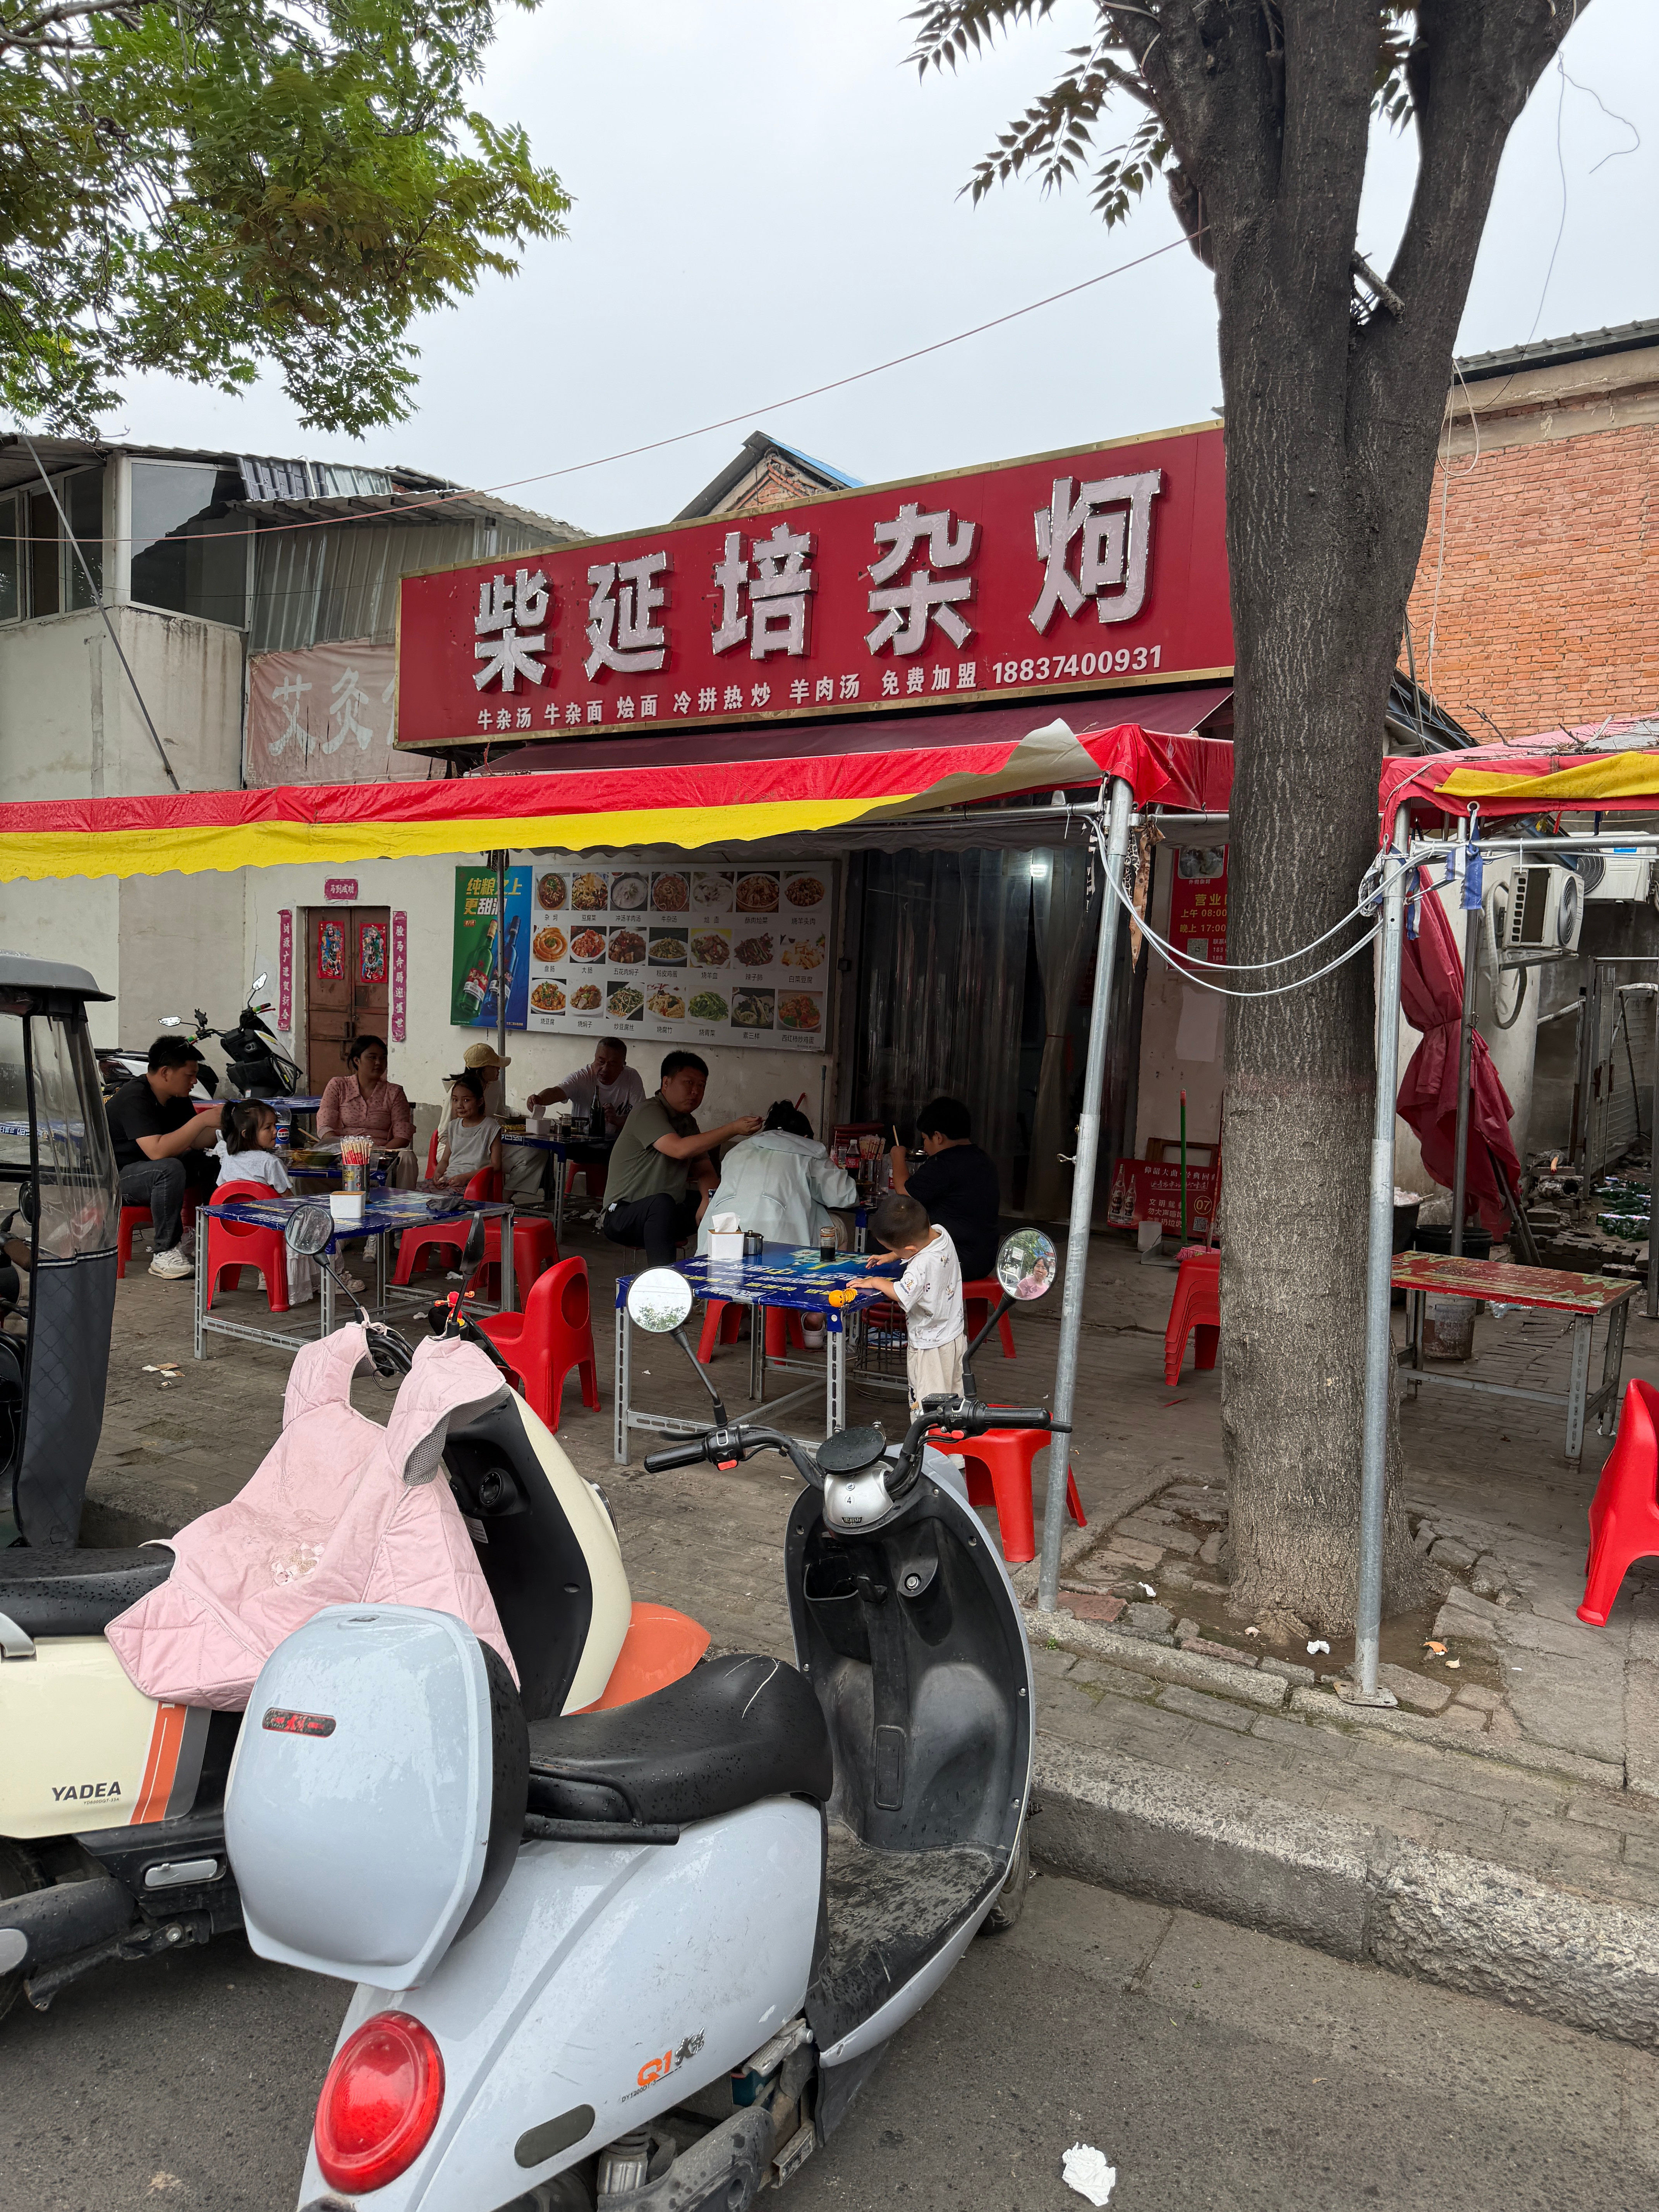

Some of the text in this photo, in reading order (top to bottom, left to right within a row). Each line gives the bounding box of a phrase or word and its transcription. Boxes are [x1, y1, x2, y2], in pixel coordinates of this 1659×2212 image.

[472, 469, 1163, 693] 柴延培杂炣
[477, 645, 1161, 730] 牛杂汤 牛杂面 烩面 冷拼热炒 羊肉汤 免费加盟 18837400931
[268, 667, 394, 756] 艾灸
[330, 883, 354, 894] 马到成功
[1195, 894, 1228, 906] 营业
[1181, 909, 1198, 917] 上午
[1180, 924, 1197, 933] 晚上
[1196, 1200, 1210, 1211] 07
[52, 1781, 121, 1801] YADEA
[637, 2049, 673, 2086] Q1
